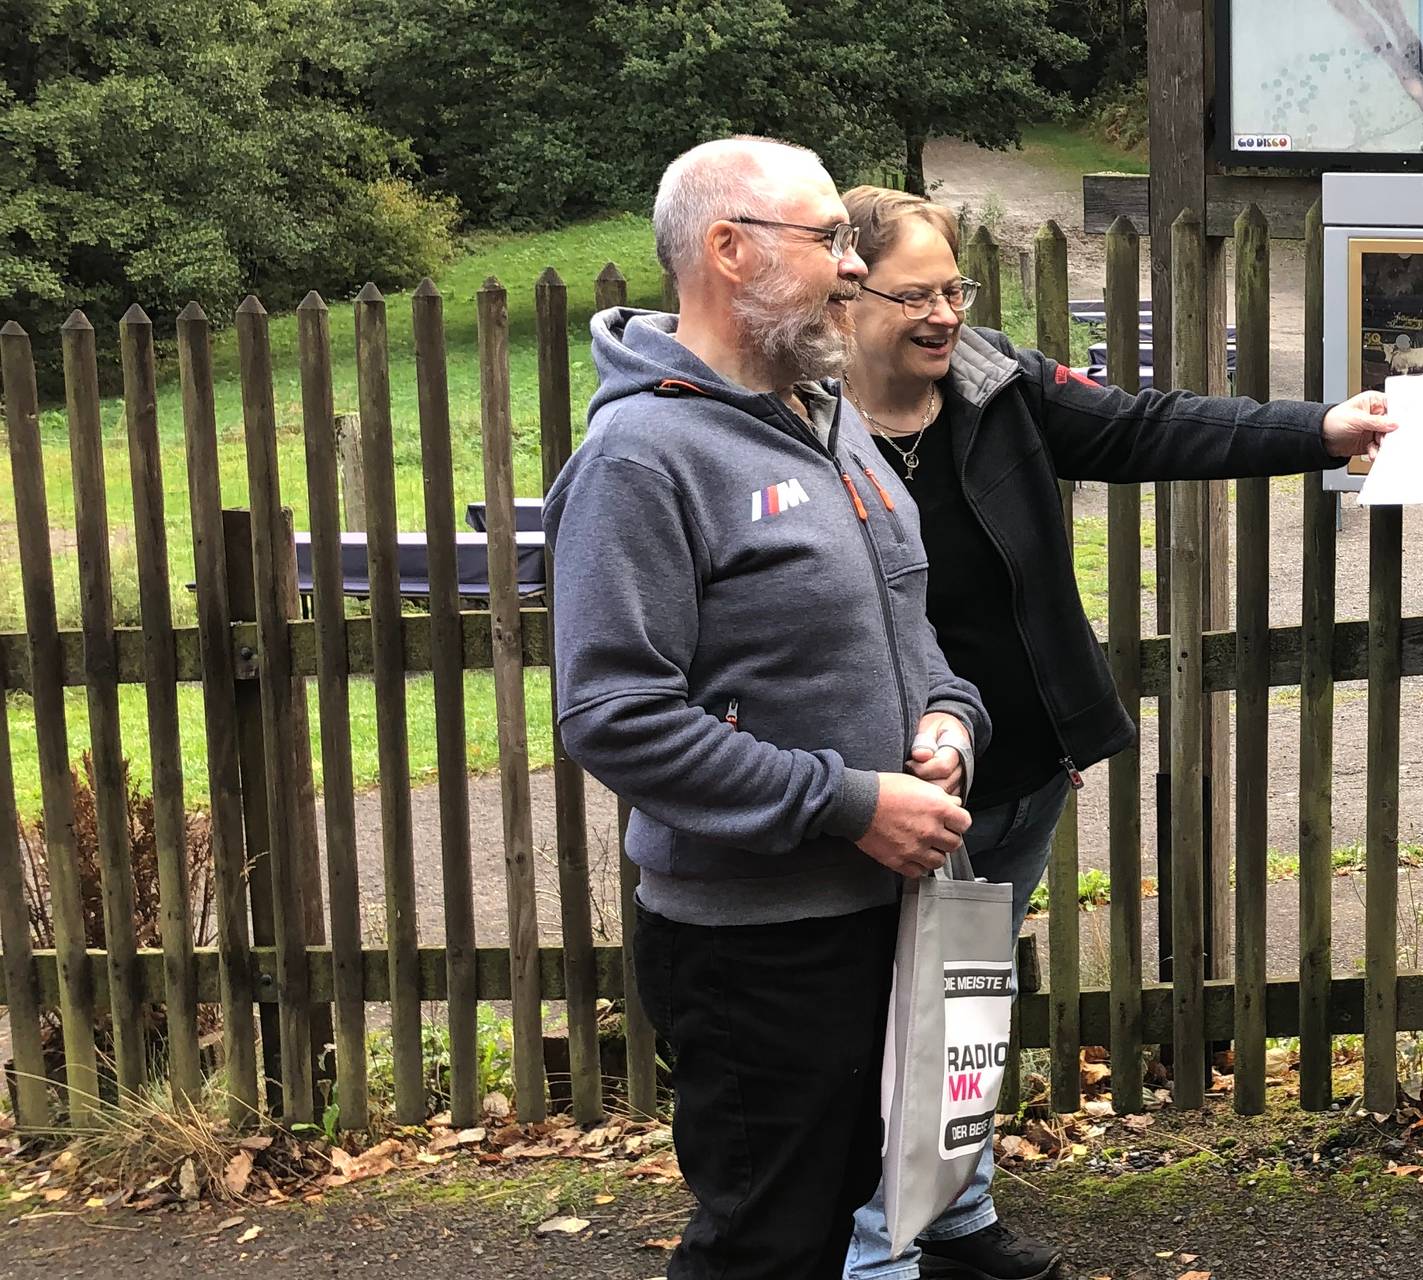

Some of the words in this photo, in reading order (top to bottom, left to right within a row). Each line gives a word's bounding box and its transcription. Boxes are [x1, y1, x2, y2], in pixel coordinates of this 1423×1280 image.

[957, 976, 1003, 990] MEISTE
[947, 1042, 1008, 1073] RADIO
[948, 1072, 982, 1102] MK
[951, 1125, 968, 1140] DER
